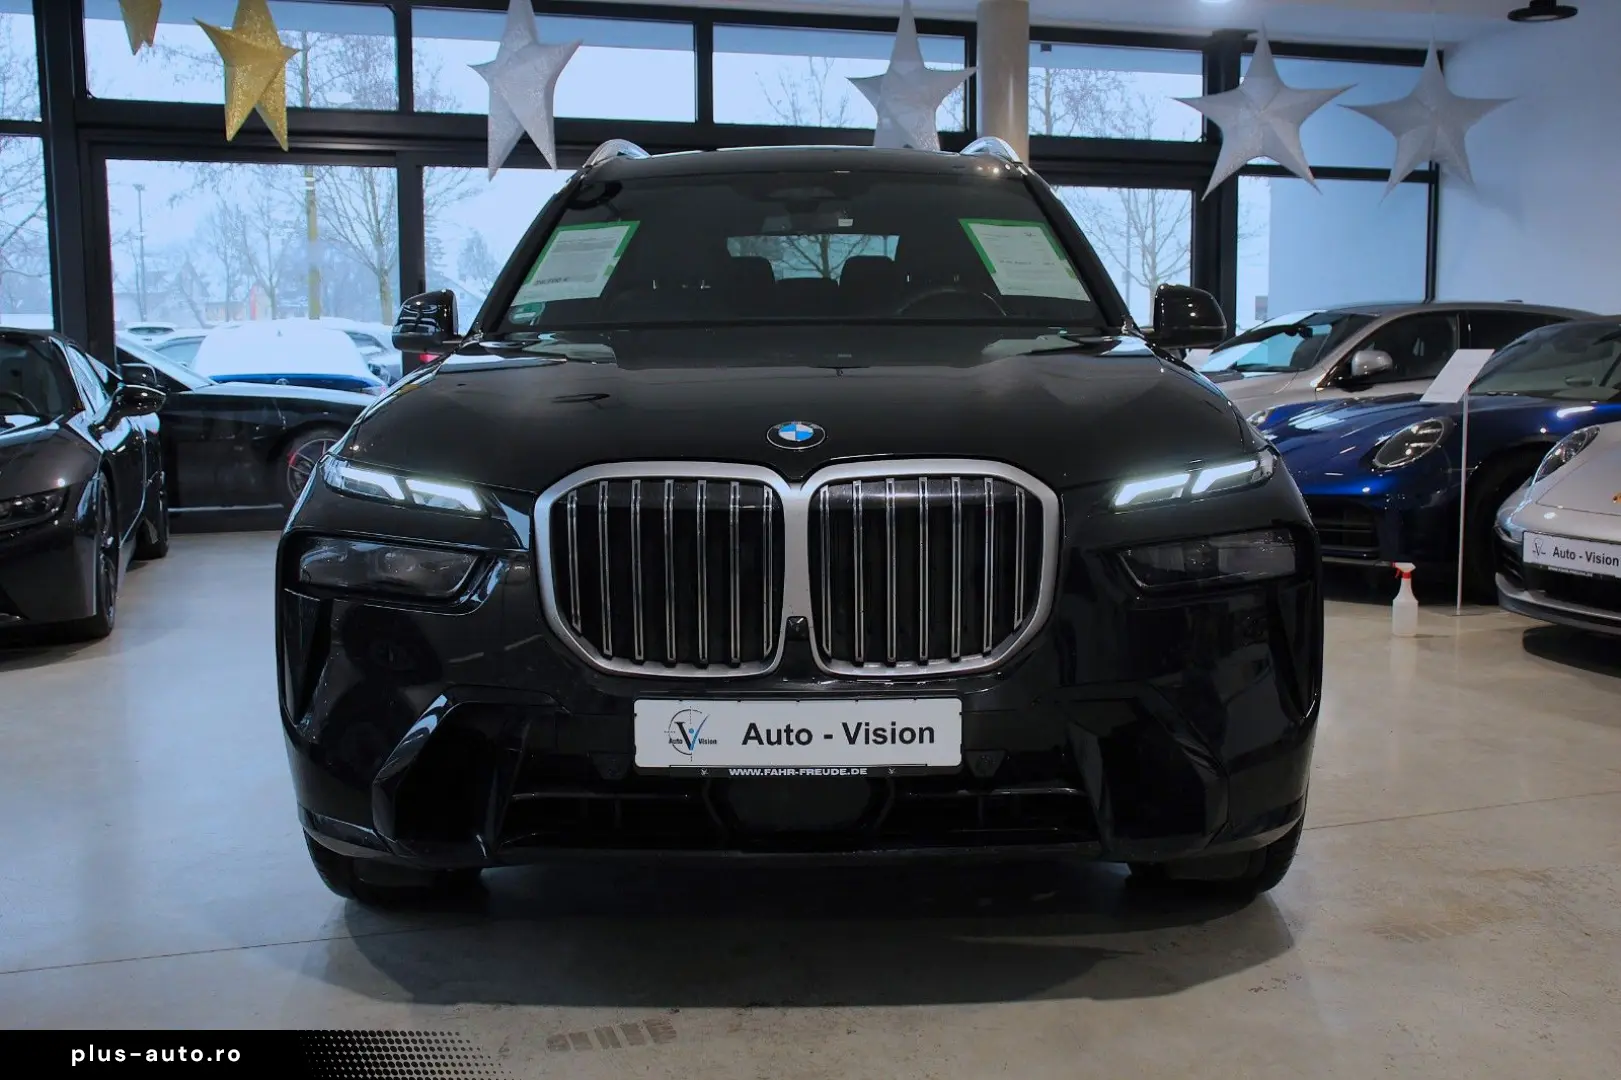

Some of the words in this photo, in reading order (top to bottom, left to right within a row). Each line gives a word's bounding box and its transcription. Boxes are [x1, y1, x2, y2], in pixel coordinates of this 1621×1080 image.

[1552, 546, 1576, 560] Auto
[1585, 550, 1619, 567] Vision
[741, 722, 813, 746] Auto
[842, 721, 935, 745] Vision
[728, 768, 868, 776] WWW.FAHR-FREUDE.DE
